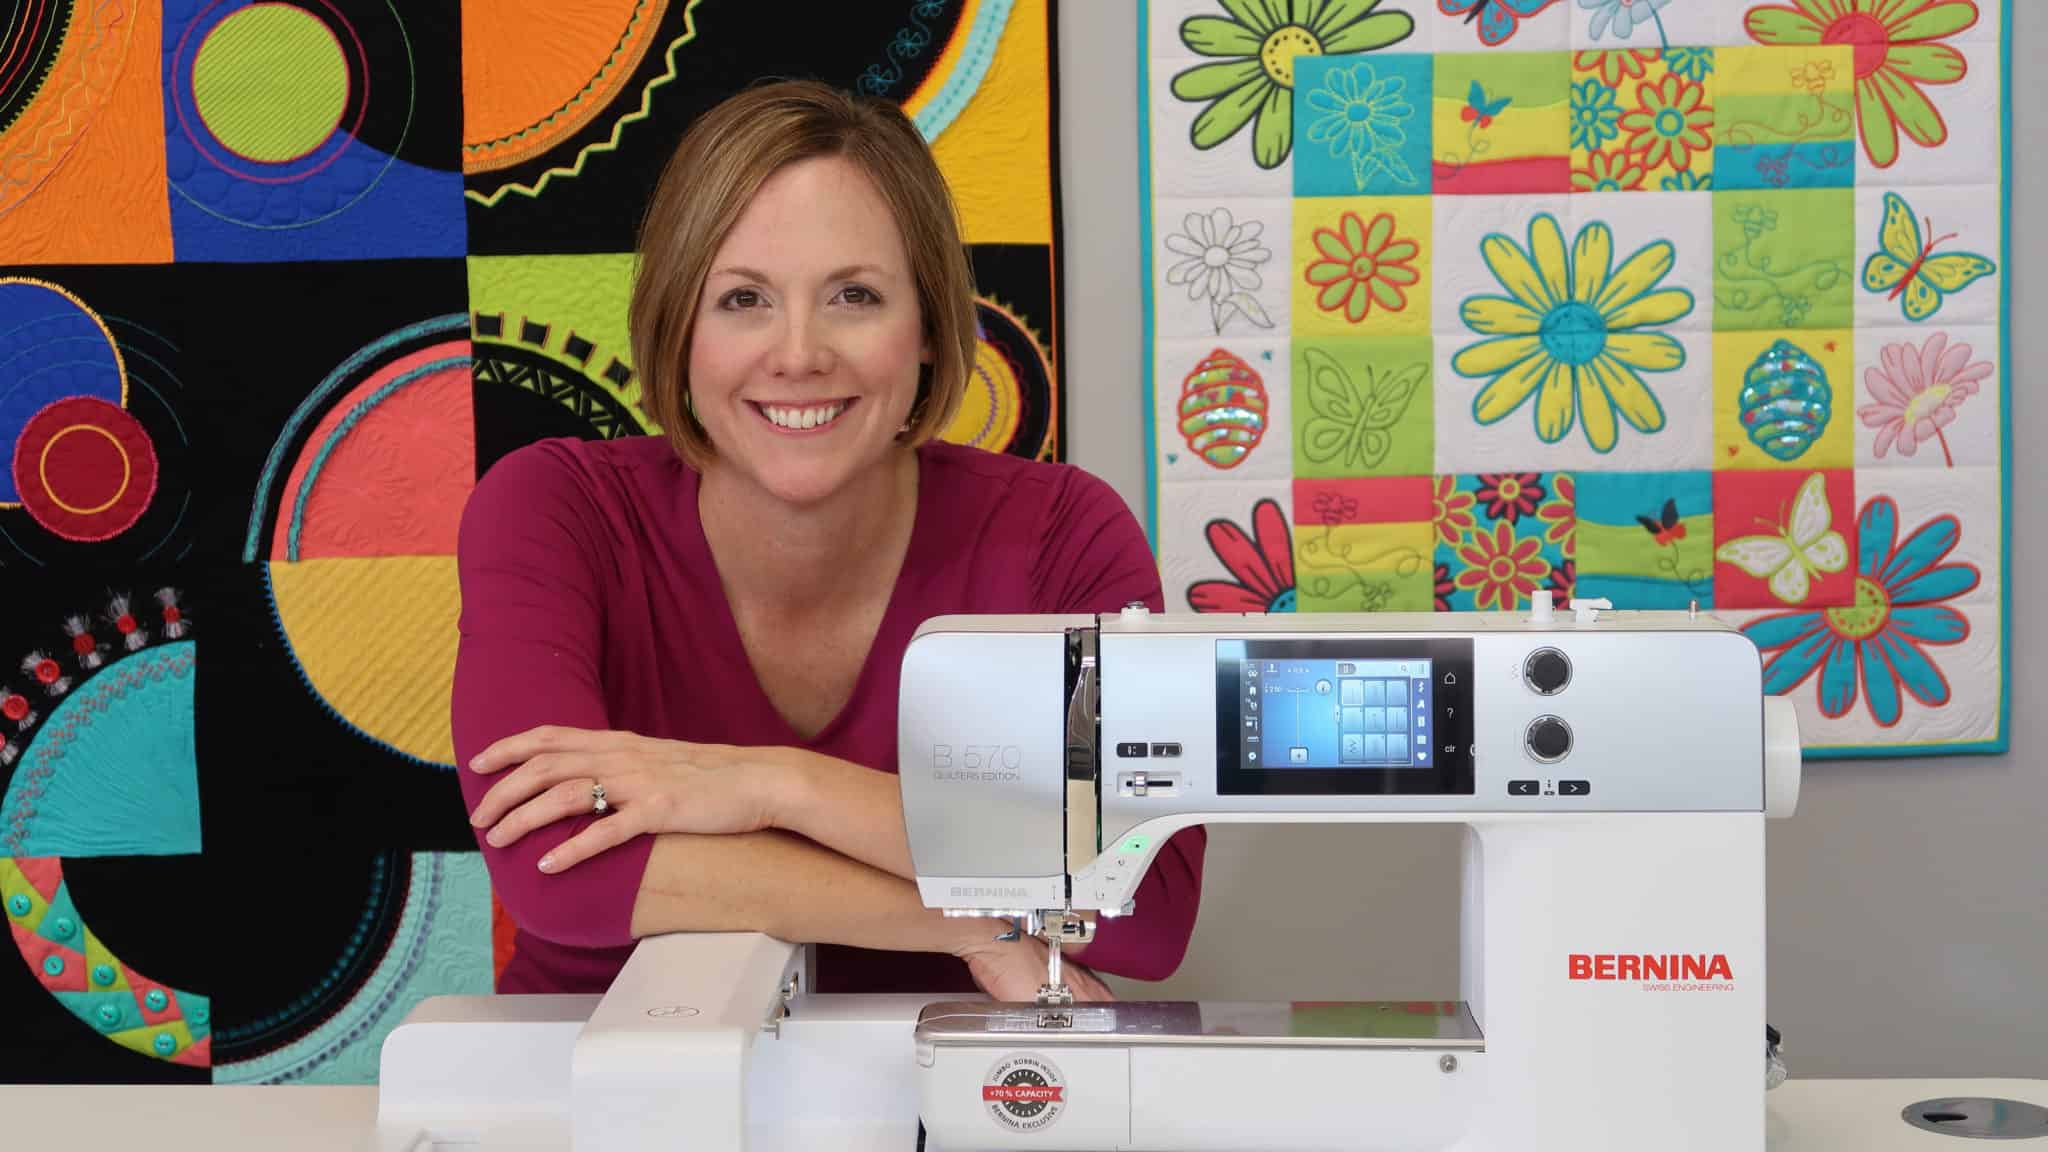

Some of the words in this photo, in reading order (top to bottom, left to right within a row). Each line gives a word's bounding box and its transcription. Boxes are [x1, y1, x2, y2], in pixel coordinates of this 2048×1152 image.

[933, 744, 952, 768] B
[964, 744, 1021, 769] 570
[1444, 743, 1456, 753] clr
[950, 887, 1028, 897] BERNINA
[1568, 954, 1733, 980] BERNINA
[1642, 983, 1671, 992] SWISS
[1673, 983, 1734, 992] ENGINEERING
[1013, 1058, 1039, 1066] BOBBIN
[1040, 1064, 1057, 1082] INSIDE
[1015, 1089, 1054, 1098] CAPACITY
[992, 1104, 1020, 1128] BERNINA
[1022, 1106, 1057, 1128] EXCLUSIVE
